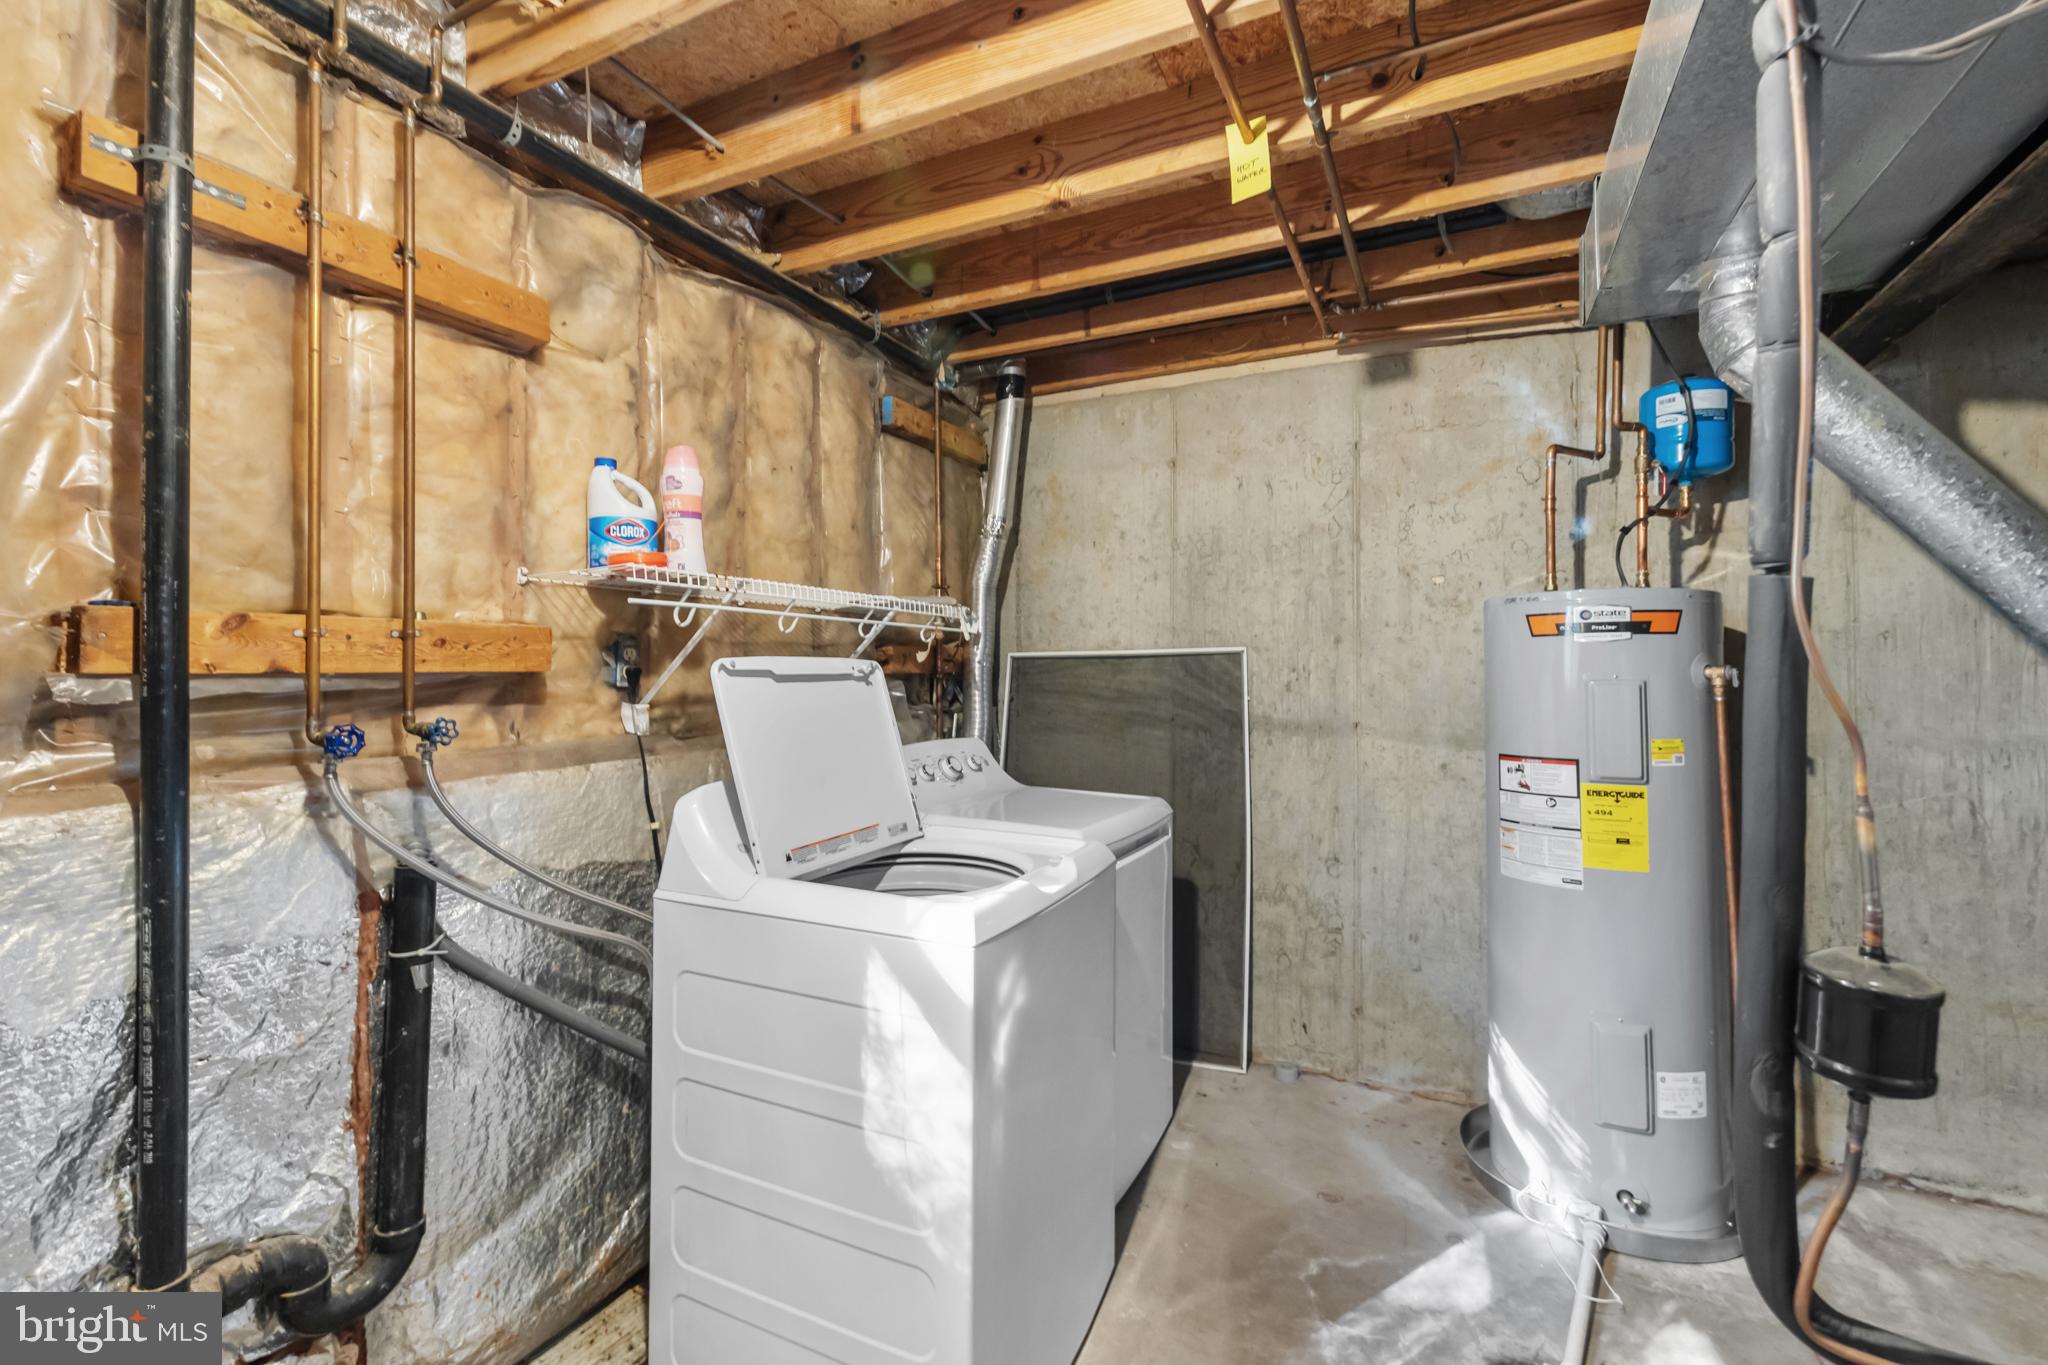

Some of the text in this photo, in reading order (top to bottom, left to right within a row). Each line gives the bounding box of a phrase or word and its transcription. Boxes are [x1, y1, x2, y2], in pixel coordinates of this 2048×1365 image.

[1236, 157, 1259, 173] HOT
[609, 525, 646, 538] CLOROX
[1593, 609, 1627, 617] state
